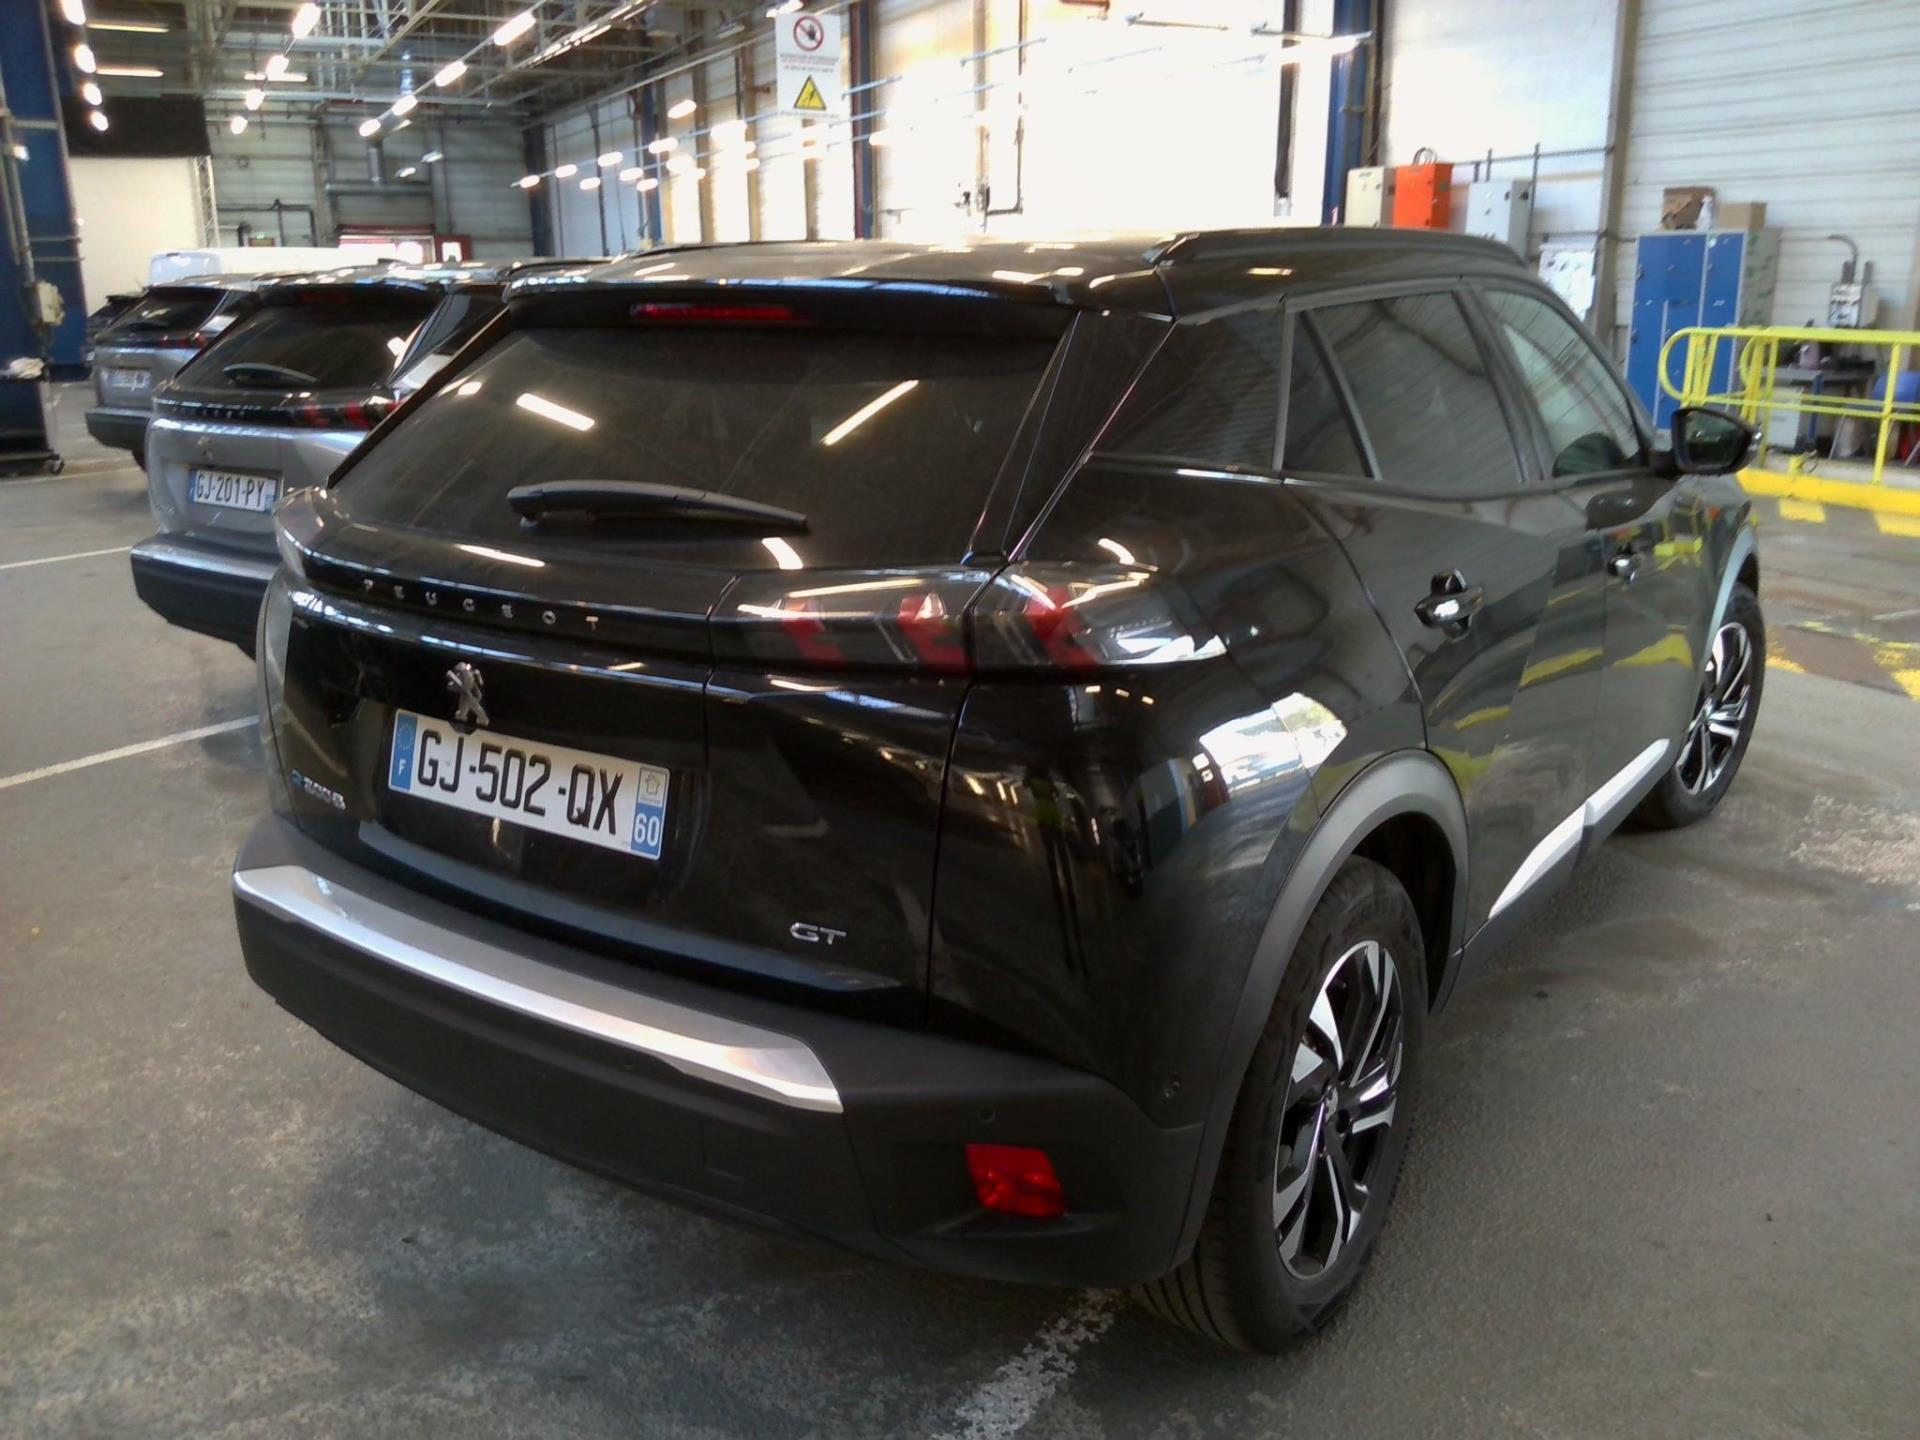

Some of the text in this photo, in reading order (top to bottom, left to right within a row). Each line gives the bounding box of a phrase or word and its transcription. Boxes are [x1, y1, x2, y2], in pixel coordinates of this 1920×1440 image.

[195, 473, 265, 508] GJ-201-PY
[397, 759, 406, 775] F
[417, 728, 624, 836] GJ-502-QX
[634, 812, 661, 847] 60
[790, 922, 847, 945] GT
